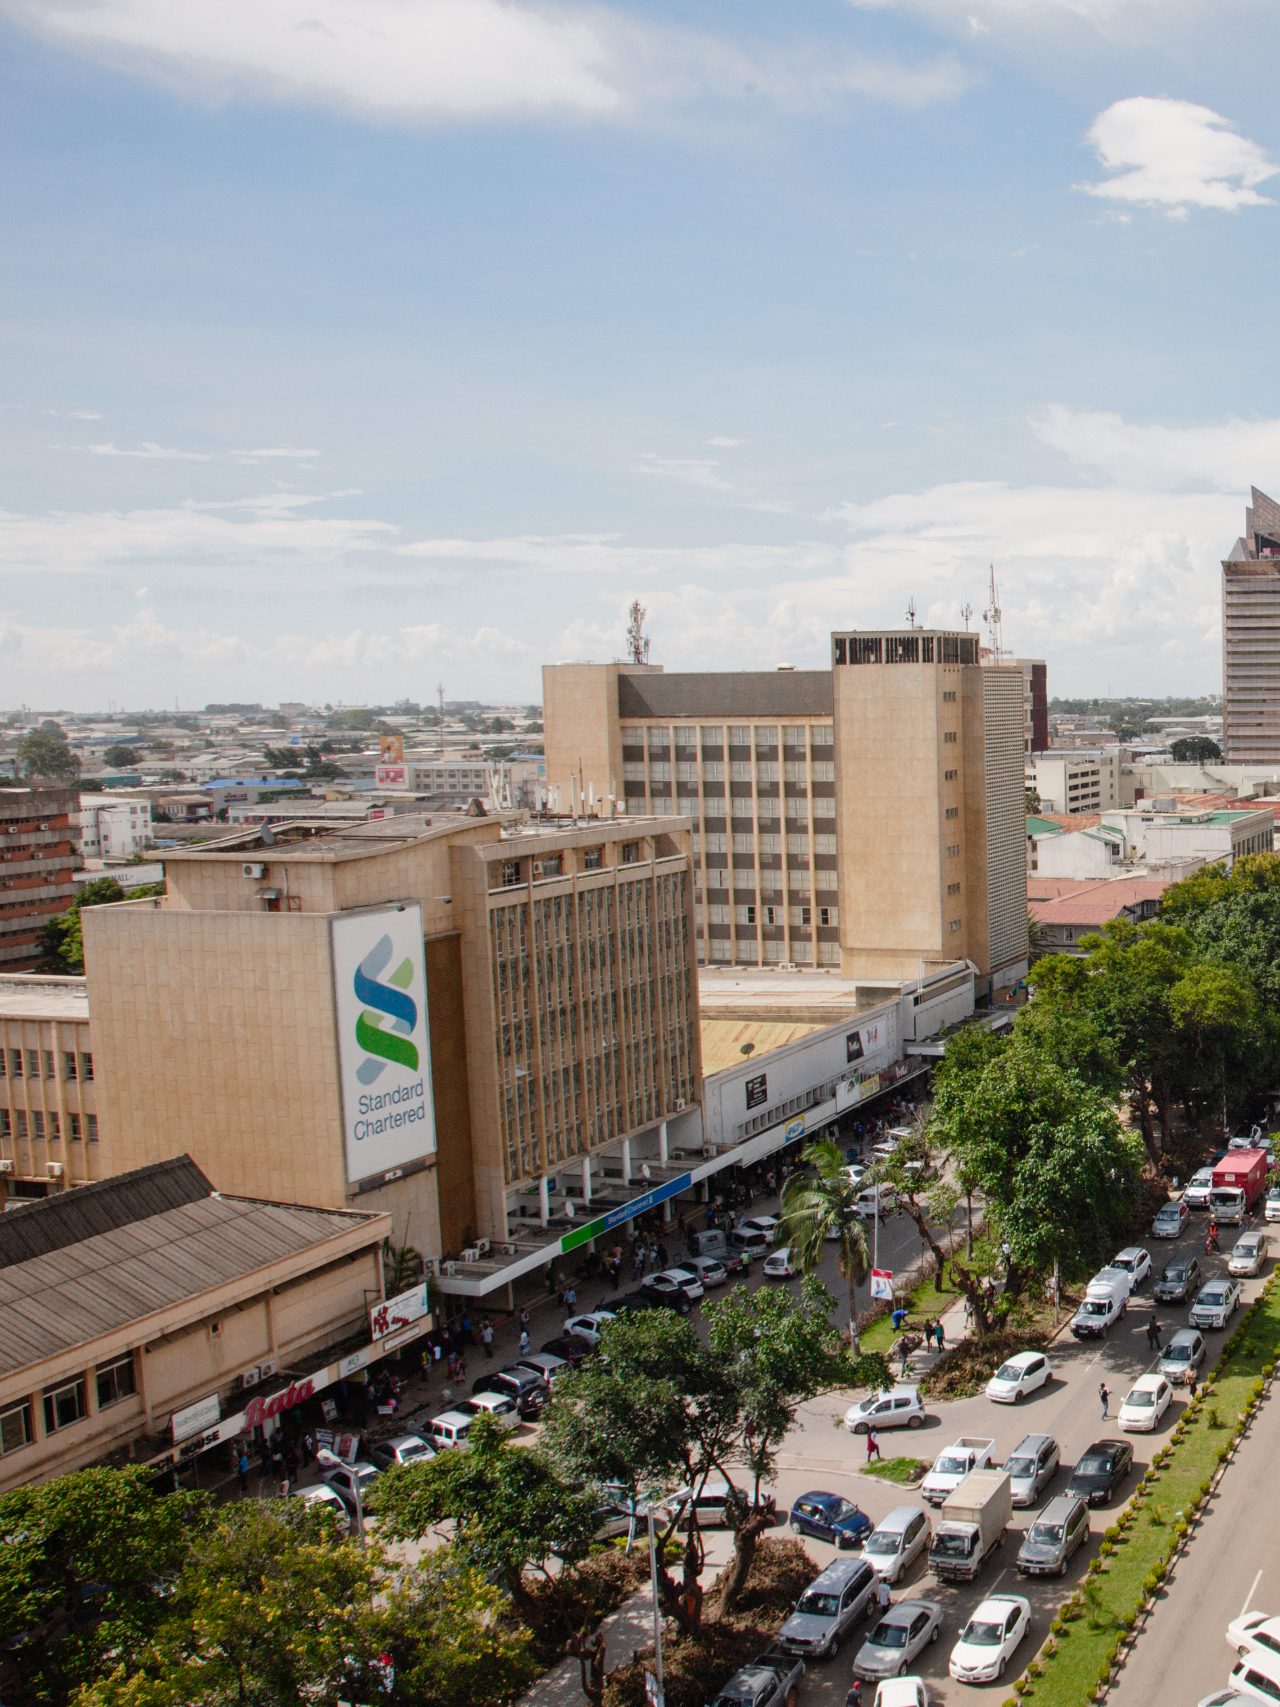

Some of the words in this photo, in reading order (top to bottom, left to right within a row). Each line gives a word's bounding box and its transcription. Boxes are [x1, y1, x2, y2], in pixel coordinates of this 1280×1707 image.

[358, 1079, 424, 1115] Standard
[353, 1103, 425, 1142] Chartered
[240, 1379, 315, 1433] Bata
